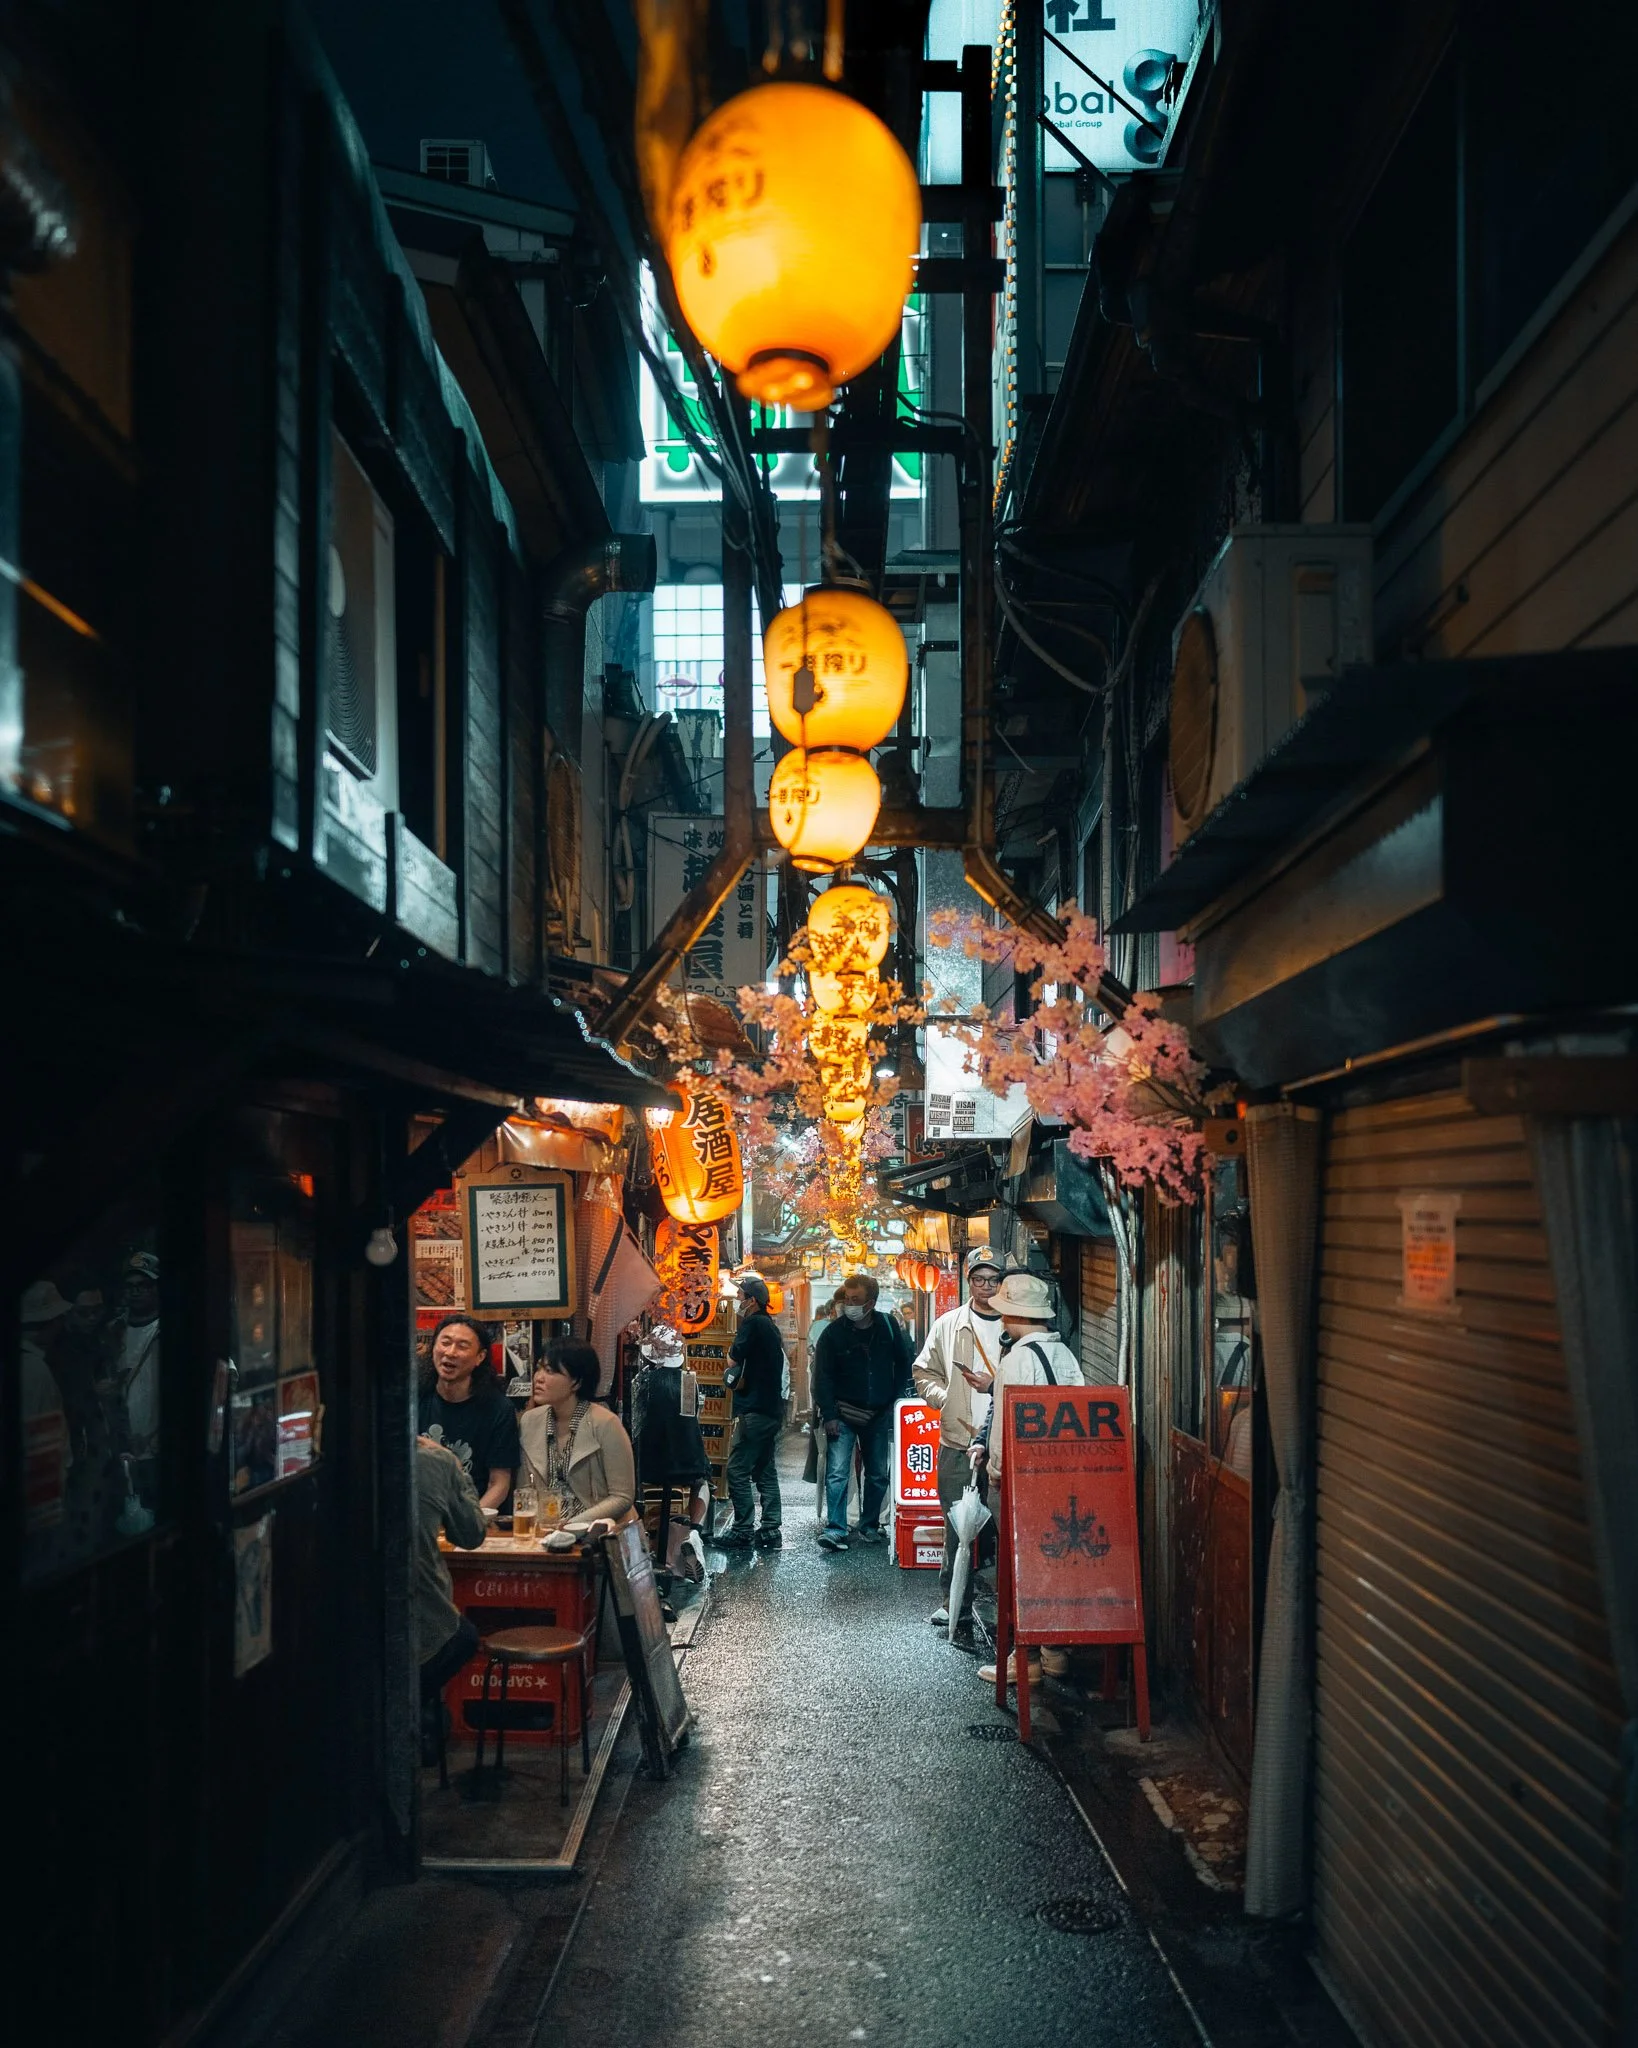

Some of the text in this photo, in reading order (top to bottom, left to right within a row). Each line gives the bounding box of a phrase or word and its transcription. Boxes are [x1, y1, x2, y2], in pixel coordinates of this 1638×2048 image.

[1075, 120, 1103, 129] Group
[930, 1093, 952, 1103] VISAH
[955, 1100, 976, 1109] VISAH
[929, 1111, 950, 1120] VISAH
[953, 1117, 974, 1125] VISAH
[683, 1091, 738, 1200] 居酒屋
[689, 1359, 725, 1372] KIRIN
[903, 1409, 926, 1425] 珍品
[1014, 1401, 1125, 1438] BAR
[917, 1418, 941, 1435] スタミ
[906, 1443, 939, 1475] 朝
[470, 1674, 533, 1689] SAPOO
